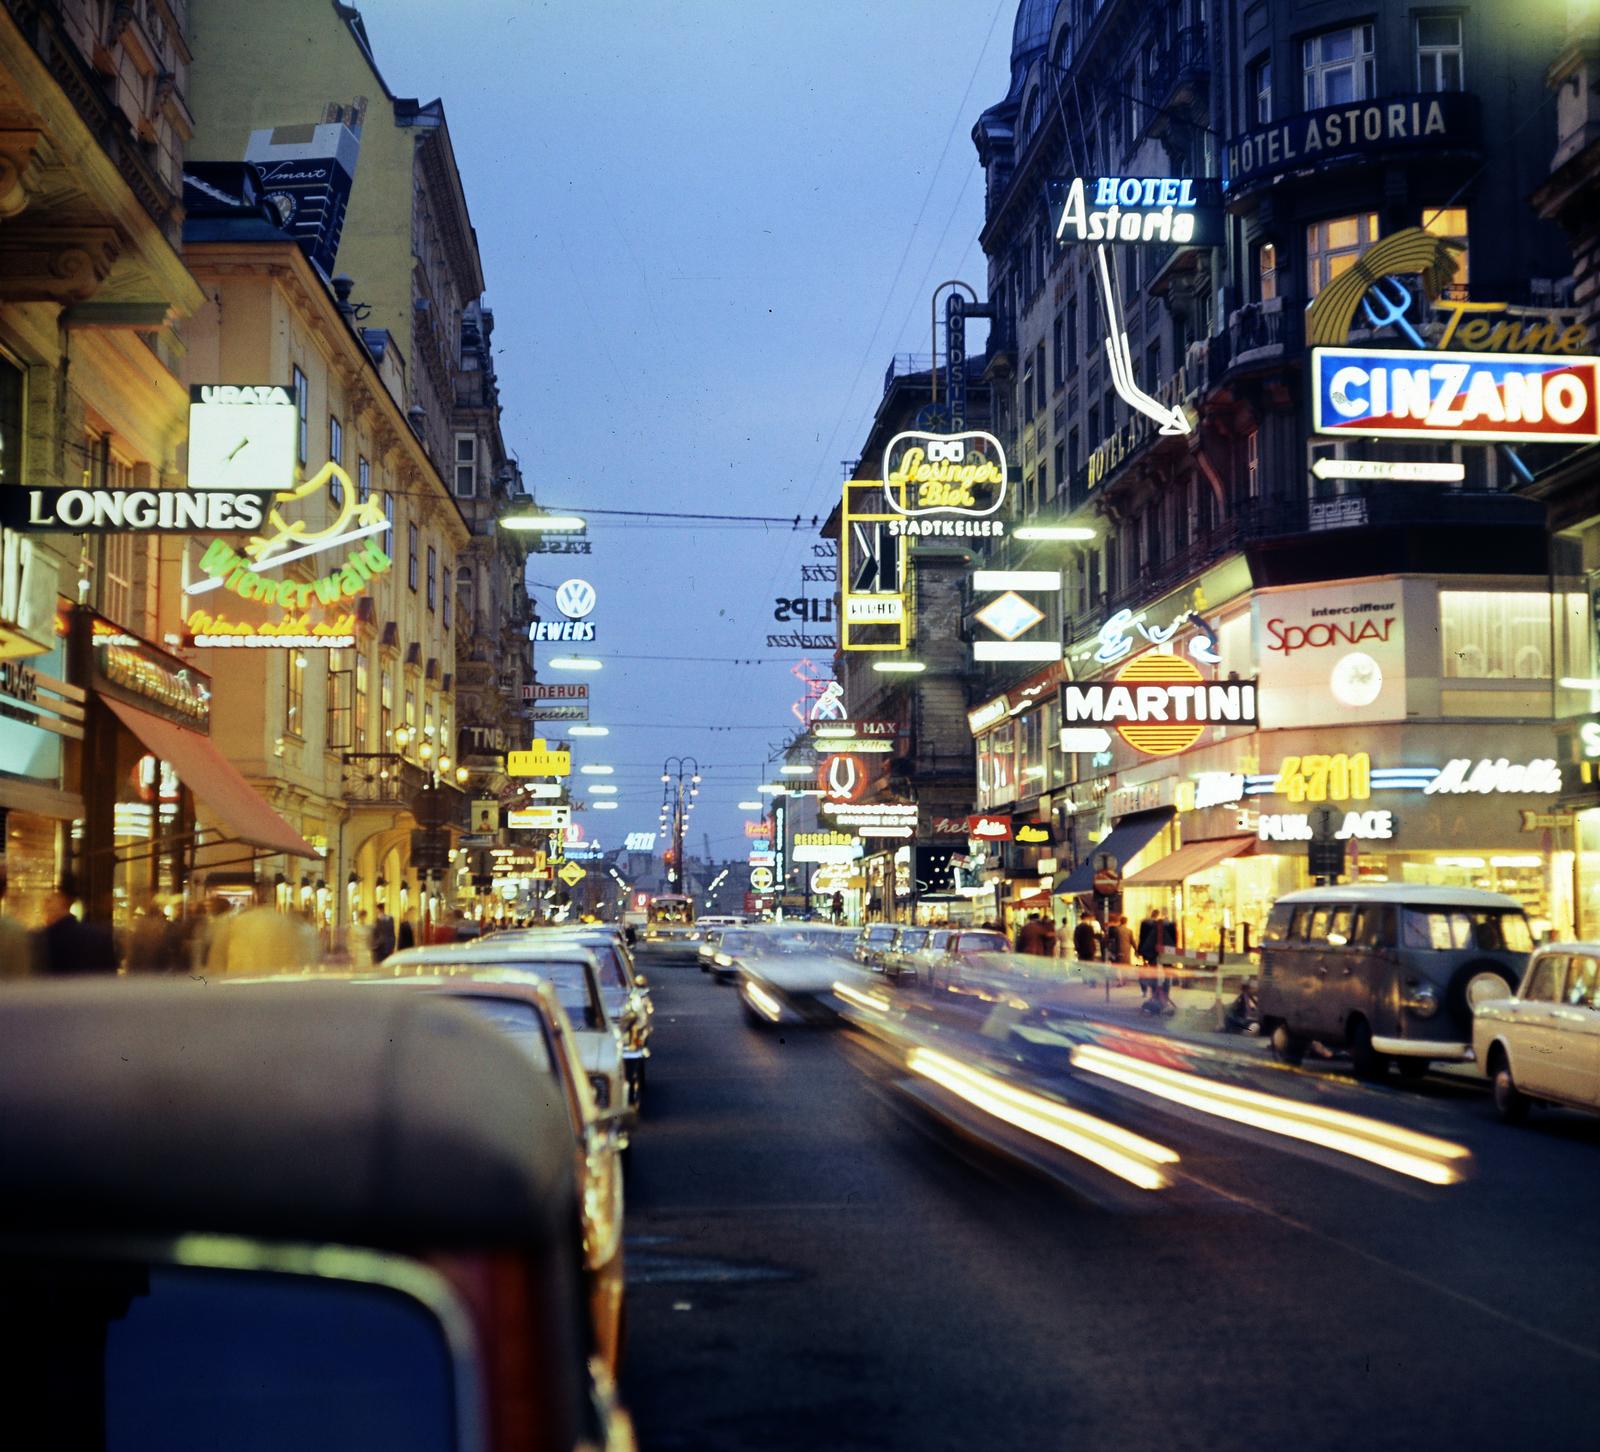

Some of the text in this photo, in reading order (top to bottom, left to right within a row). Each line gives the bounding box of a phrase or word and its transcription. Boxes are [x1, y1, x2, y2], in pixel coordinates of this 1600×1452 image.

[1305, 100, 1447, 151] ASTORIA
[1056, 178, 1196, 243] Astoria
[1095, 178, 1197, 207] HOTEL
[1431, 300, 1589, 352] Tenne
[1330, 364, 1588, 427] CINZANO
[889, 447, 1003, 486] Liesinger
[29, 489, 263, 530] LONGINES
[918, 481, 975, 507] Bier
[889, 520, 1004, 537] STADTKELLER
[199, 537, 393, 608] Wienerwald
[1312, 602, 1396, 617] intercoiffeur
[1066, 685, 1256, 722] MARTINI
[863, 721, 897, 734] MAX
[1274, 752, 1370, 802] 4711
